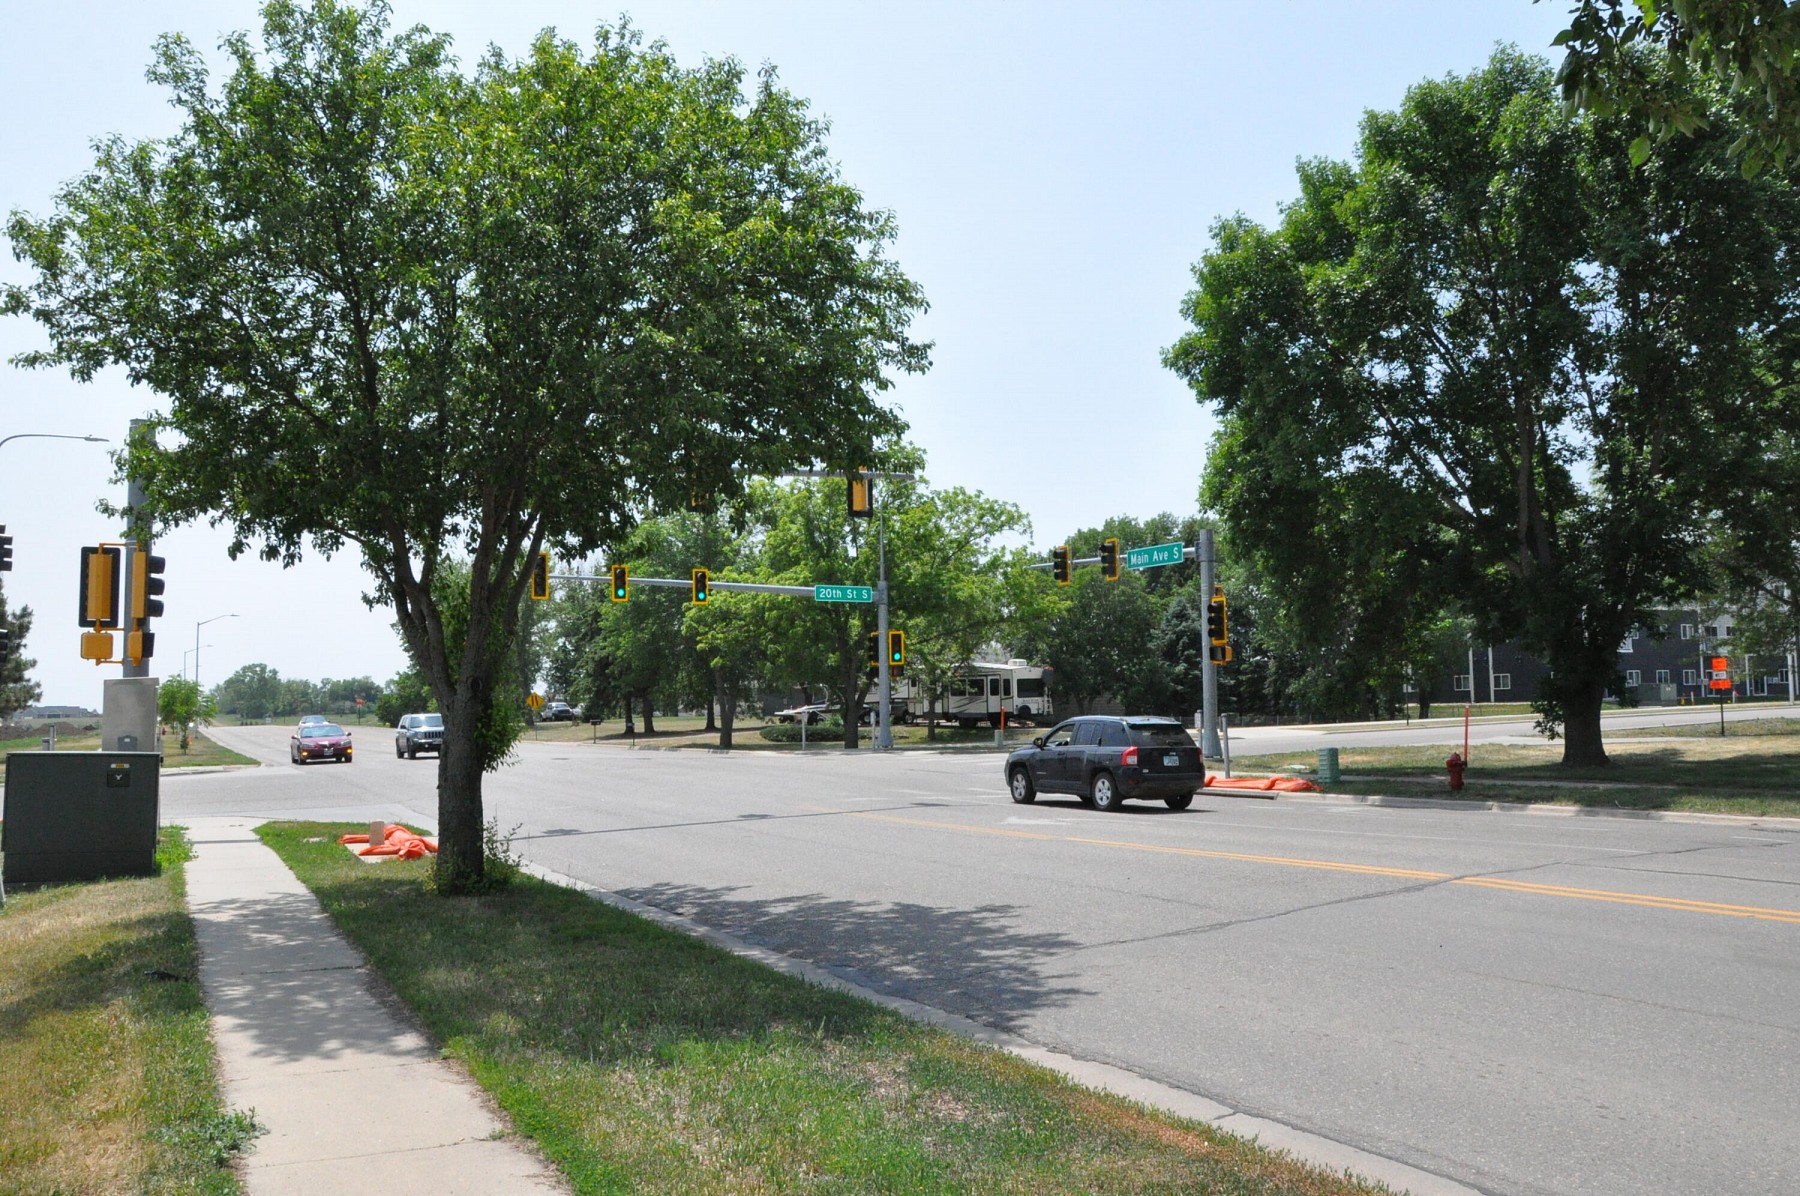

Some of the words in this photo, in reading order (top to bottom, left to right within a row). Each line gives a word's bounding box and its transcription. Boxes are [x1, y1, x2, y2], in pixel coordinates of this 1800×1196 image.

[1130, 553, 1149, 565] Main
[1152, 550, 1169, 562] Ave
[1173, 547, 1179, 559] S
[819, 588, 842, 598] 20th
[846, 589, 857, 599] St
[861, 590, 868, 599] S
